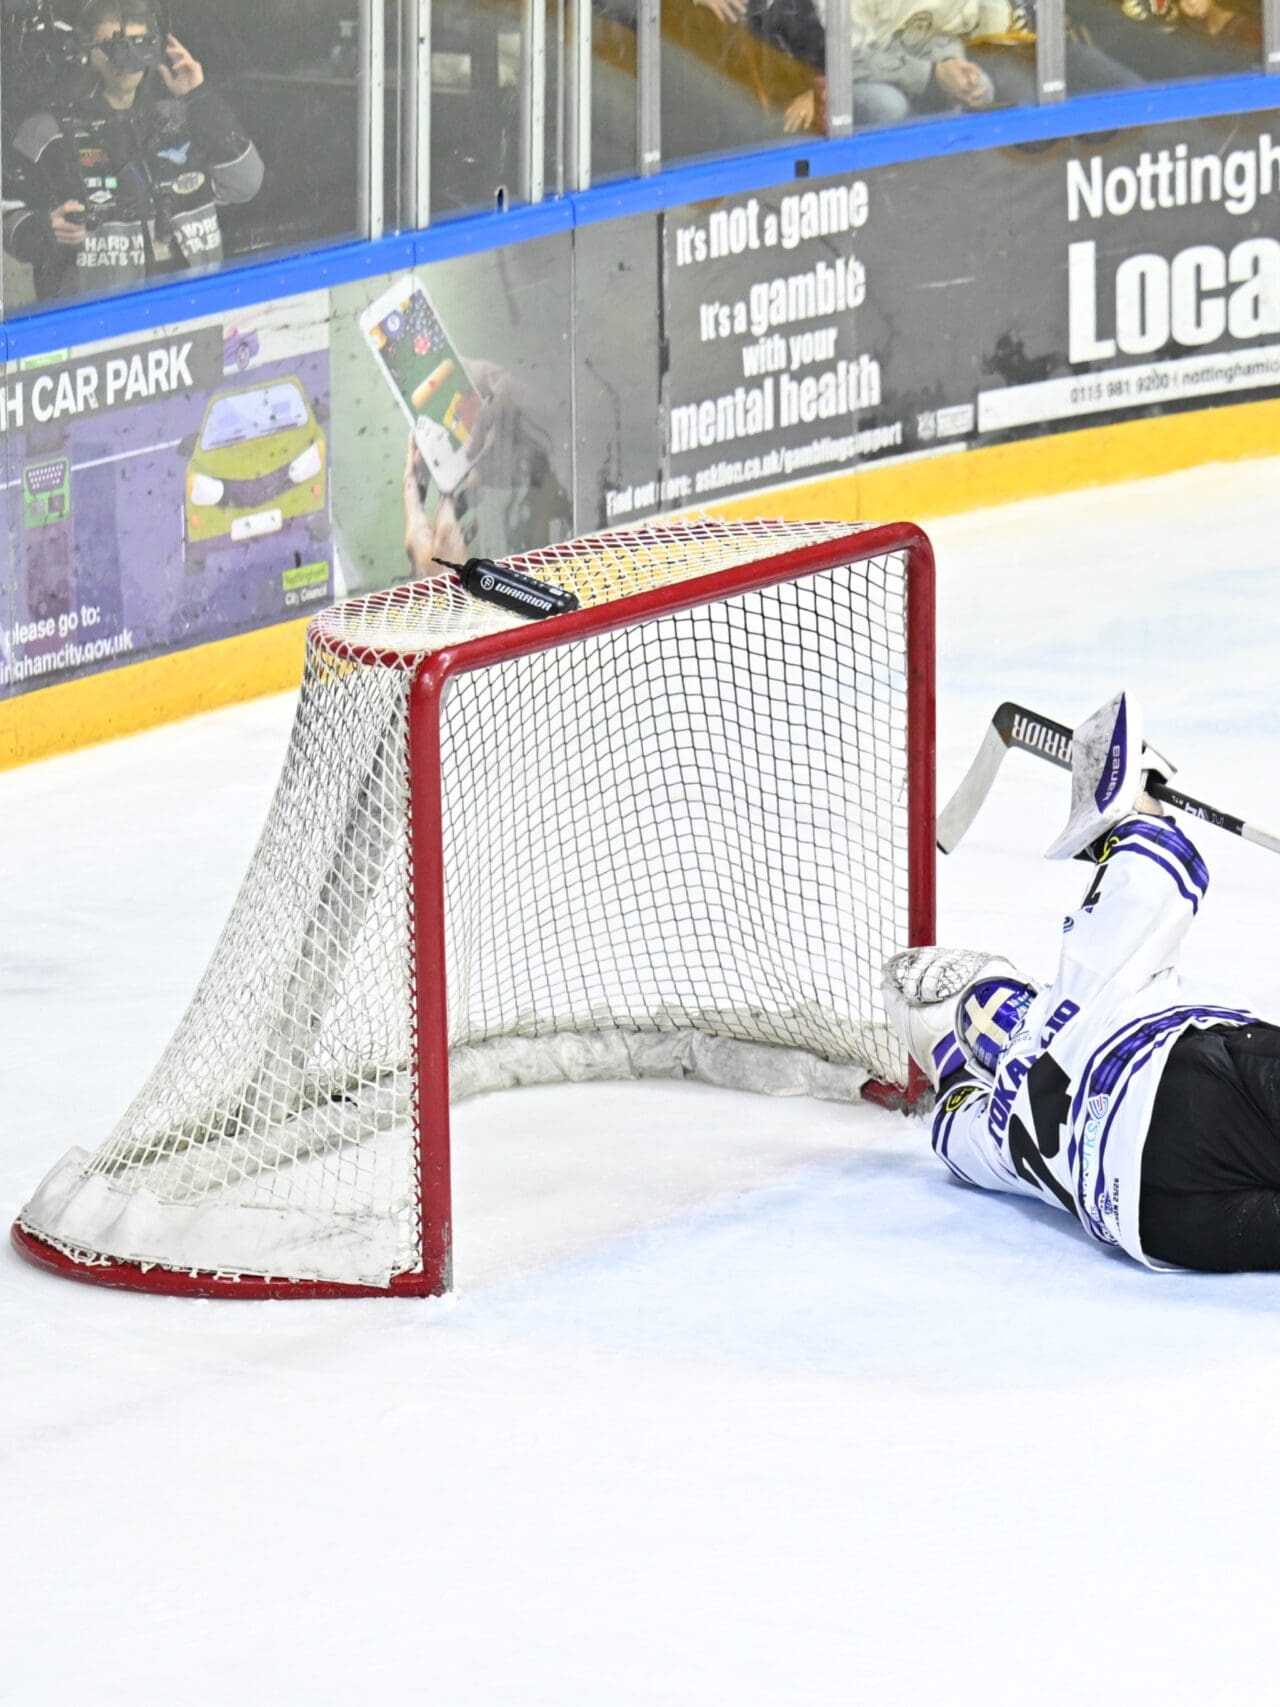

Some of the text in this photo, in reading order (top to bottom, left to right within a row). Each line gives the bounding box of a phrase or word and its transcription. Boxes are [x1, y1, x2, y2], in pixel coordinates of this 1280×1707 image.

[676, 180, 869, 266] It's not a game
[700, 254, 866, 342] It's a gamble
[742, 326, 838, 378] with your
[31, 365, 99, 422] CAR
[106, 342, 193, 406] PARK
[670, 376, 775, 455] mental
[779, 353, 881, 428] health
[1070, 386, 1103, 404] 0115
[59, 611, 78, 638] go
[81, 604, 100, 627] to:
[494, 583, 553, 612] WARRIOR
[1011, 713, 1073, 763] RRIOR
